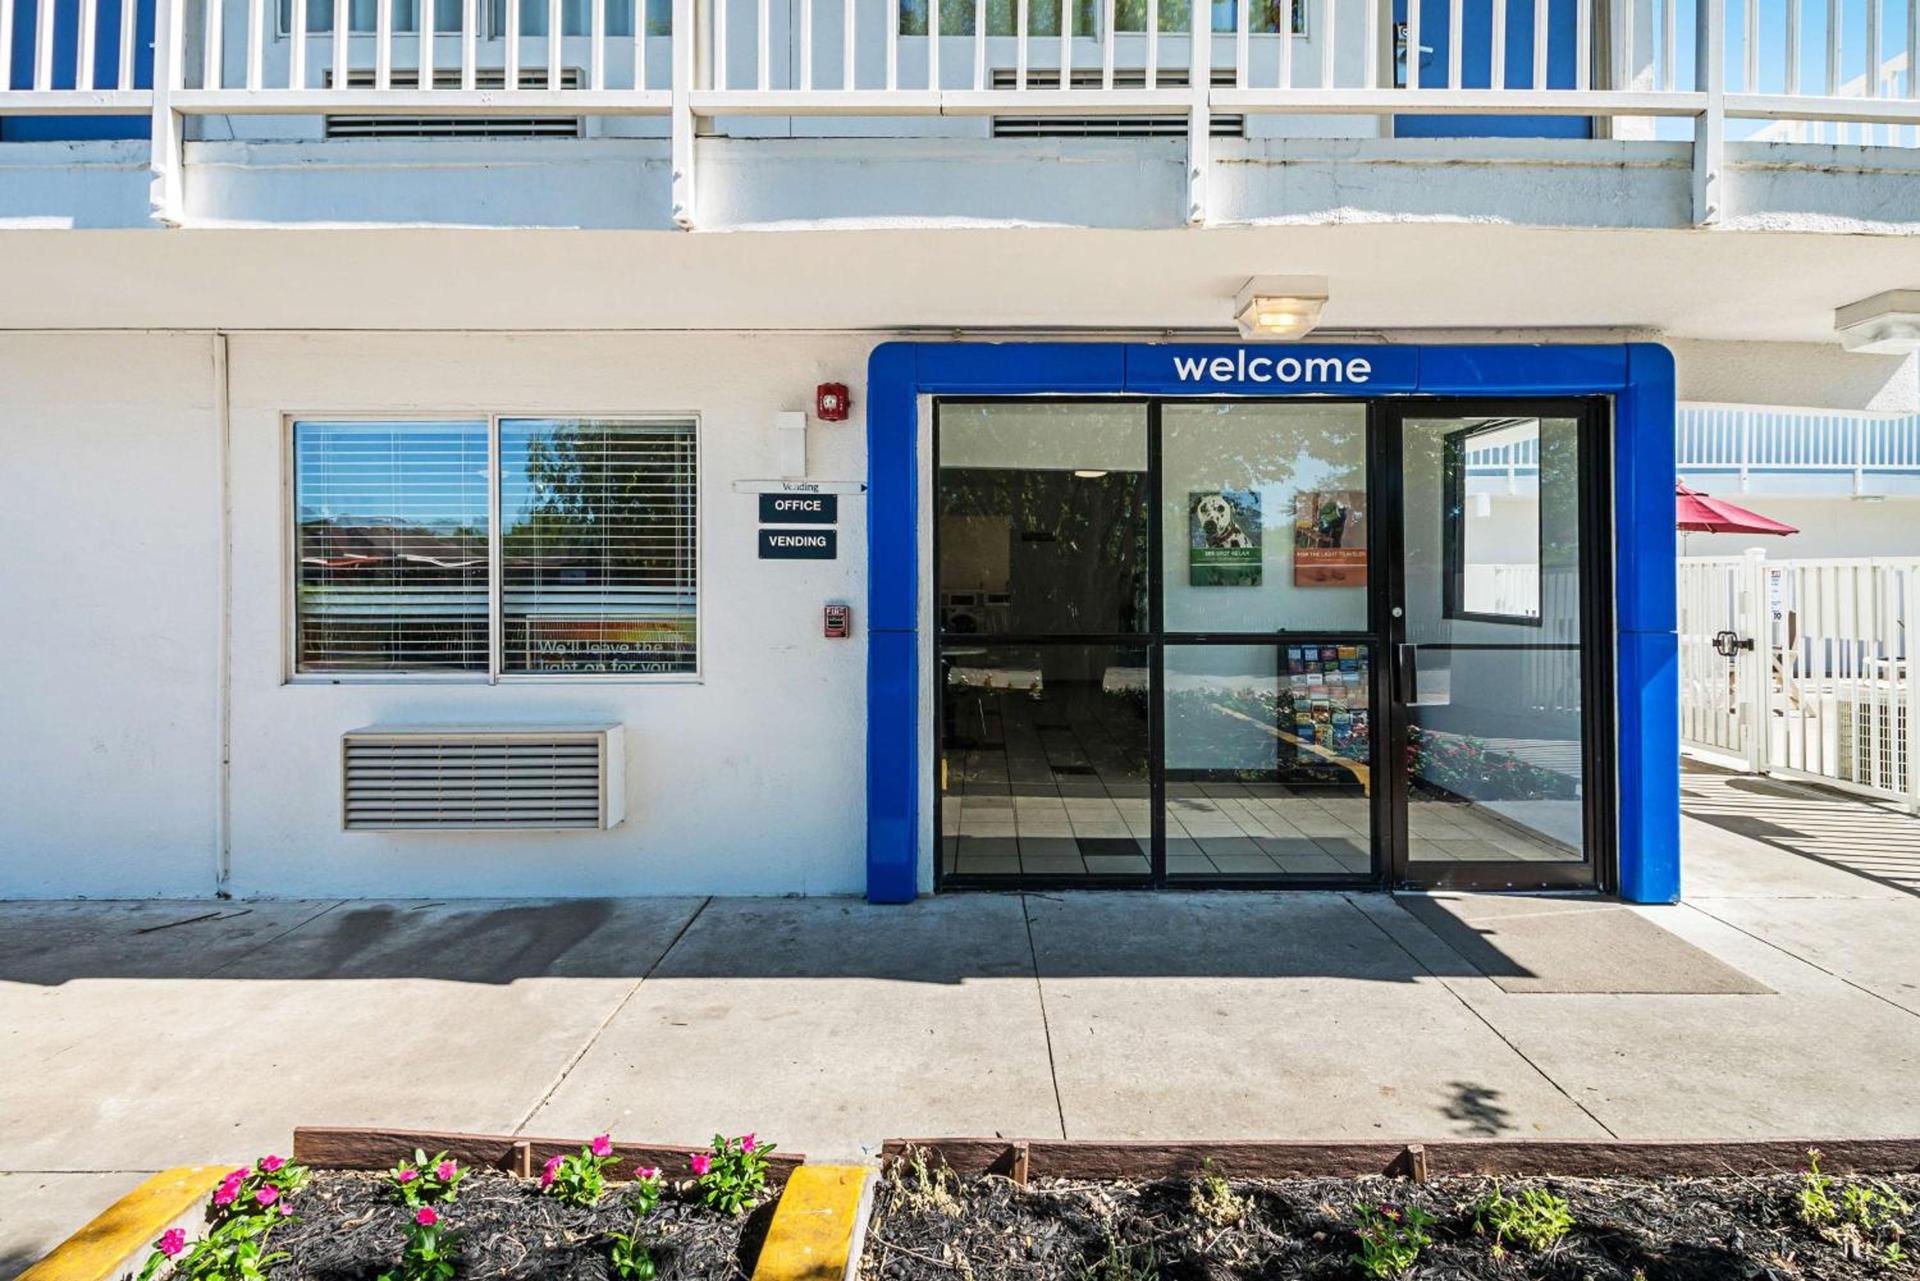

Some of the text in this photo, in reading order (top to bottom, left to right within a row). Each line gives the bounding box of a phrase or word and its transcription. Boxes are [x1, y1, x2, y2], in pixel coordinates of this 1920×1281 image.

[1173, 349, 1372, 383] welcome
[775, 500, 821, 511] OFFICE
[769, 536, 827, 547] VENDING
[538, 640, 664, 654] We'll leave the
[610, 658, 636, 672] for
